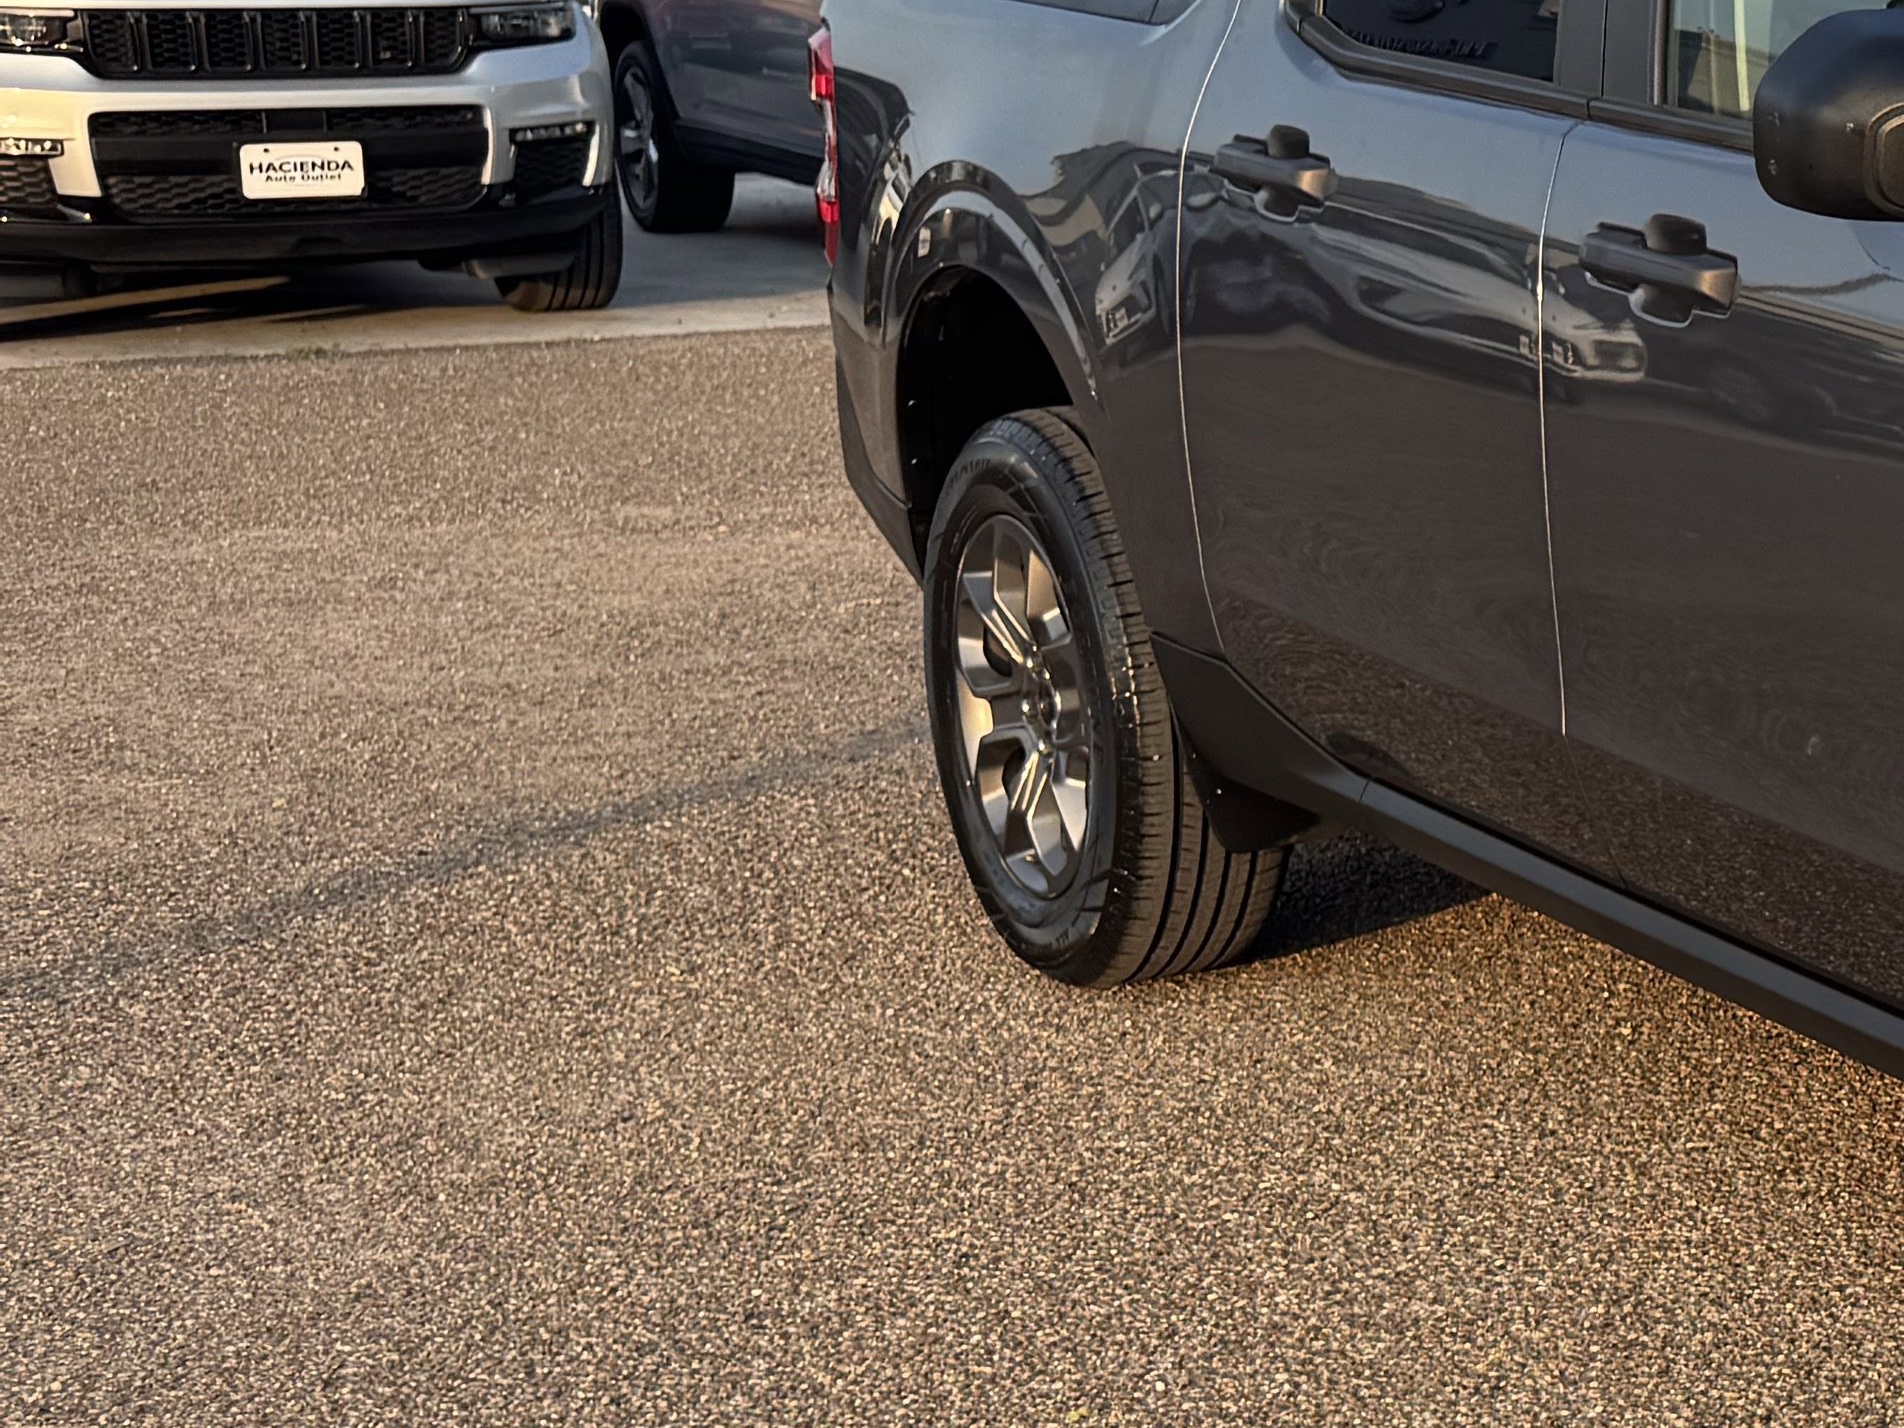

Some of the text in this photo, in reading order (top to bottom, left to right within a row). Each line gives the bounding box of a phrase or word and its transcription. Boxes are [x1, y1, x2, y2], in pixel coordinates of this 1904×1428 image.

[248, 160, 354, 175] HACIENDA
[264, 172, 342, 183] Auto Outlet
